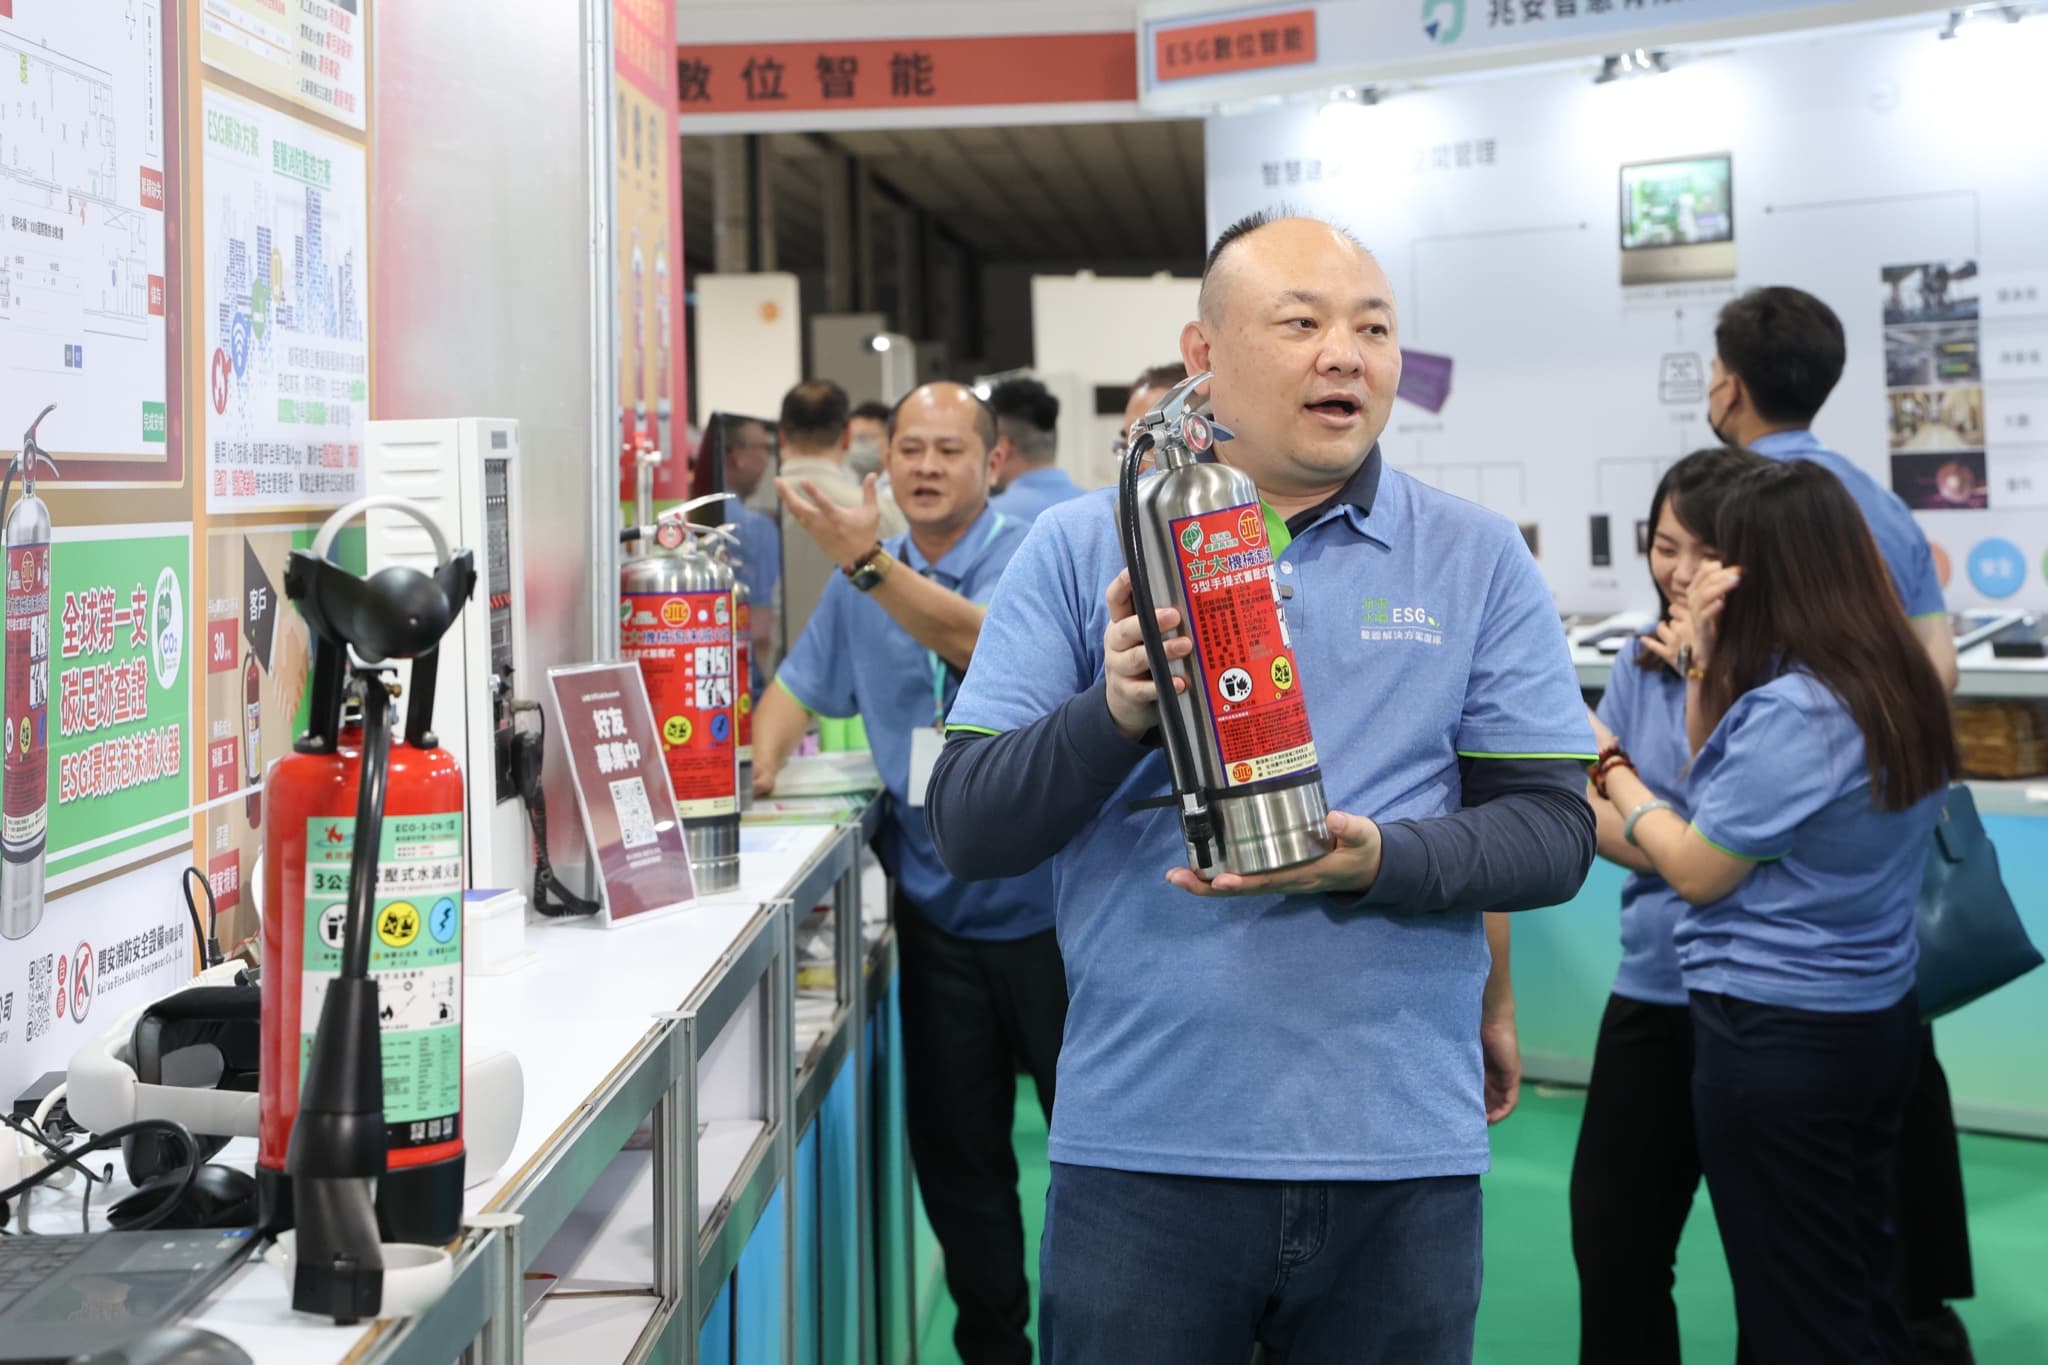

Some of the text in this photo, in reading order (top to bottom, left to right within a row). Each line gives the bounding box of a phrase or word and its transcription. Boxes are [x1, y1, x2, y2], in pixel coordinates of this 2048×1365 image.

[678, 52, 936, 101] 數位智能
[61, 584, 148, 658] 全球第一支
[1392, 607, 1426, 623] ESG
[213, 632, 225, 662] 30
[60, 656, 148, 736] 碳足跡查證
[593, 706, 628, 738] 好友
[59, 724, 181, 805] ESG環保泡沫滅火器
[594, 739, 641, 774] 募集中
